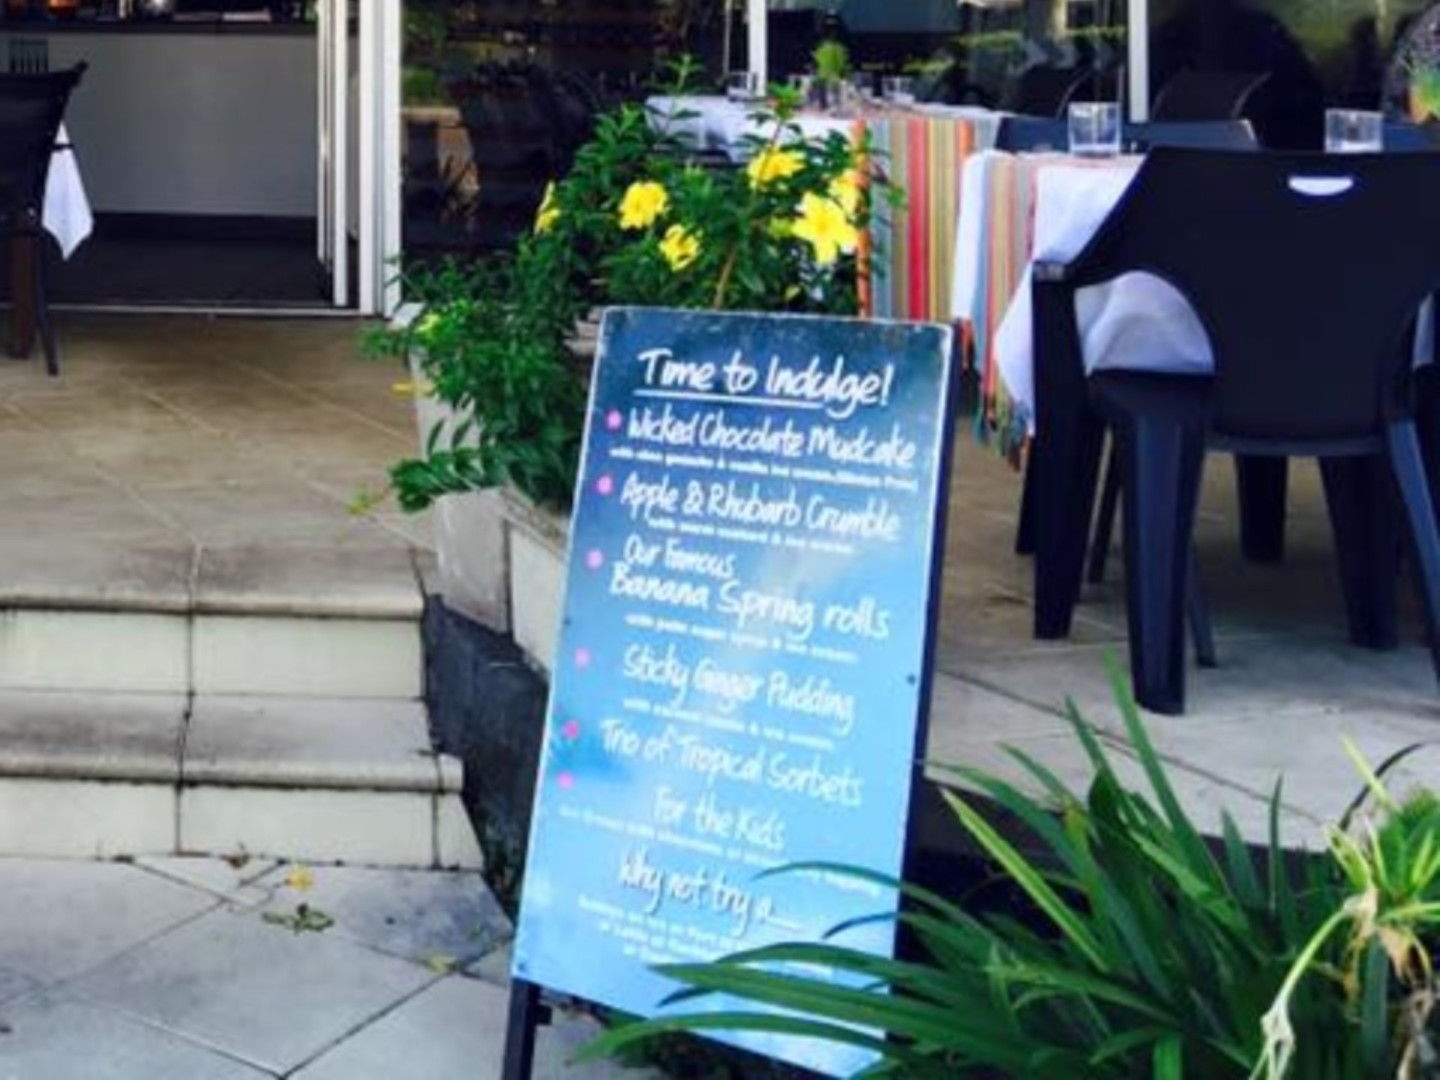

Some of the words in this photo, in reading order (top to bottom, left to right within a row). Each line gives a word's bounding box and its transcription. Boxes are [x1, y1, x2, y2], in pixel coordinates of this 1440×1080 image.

[637, 348, 715, 390] Time
[723, 350, 758, 393] to
[764, 354, 894, 419] Indulge!
[627, 404, 701, 446] Wicked
[699, 408, 805, 457] Chocolate
[809, 422, 916, 466] Mudcake
[621, 472, 678, 520] Apple
[682, 480, 705, 515] &
[709, 480, 802, 526] Rhubarb
[806, 495, 902, 541] Crumble
[624, 533, 662, 566] Our
[664, 537, 737, 579] Famous
[611, 560, 710, 610] Banana
[717, 580, 816, 642] Spring
[824, 596, 892, 640] rolls
[623, 643, 690, 708] Sticky
[767, 671, 856, 736] Pudding
[600, 718, 640, 756] Trio
[644, 724, 678, 761] of
[677, 734, 767, 786] Tropical
[768, 752, 864, 806] Sorbets
[693, 792, 734, 838] the
[712, 871, 754, 939] try
